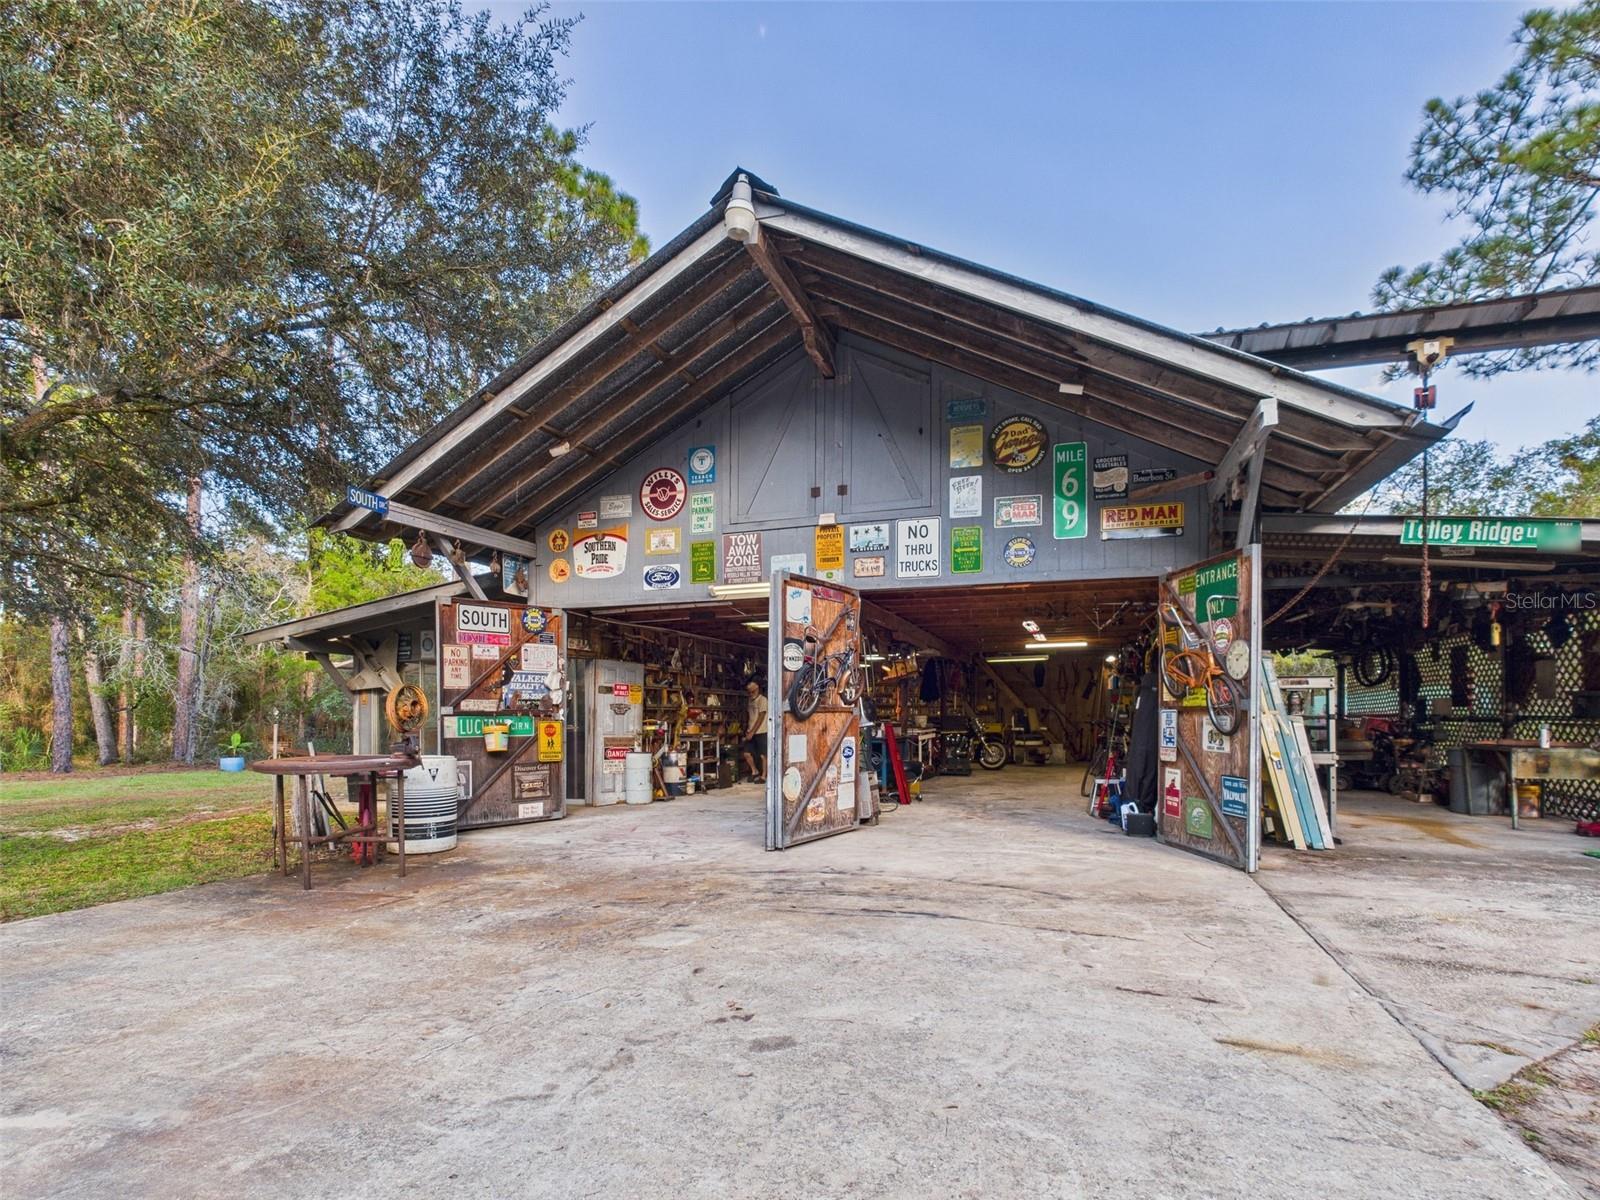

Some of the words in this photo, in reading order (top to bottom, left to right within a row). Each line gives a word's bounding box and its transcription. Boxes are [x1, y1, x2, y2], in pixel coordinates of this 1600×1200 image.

[1056, 449, 1084, 463] MILE
[645, 471, 681, 487] WILLYS
[1062, 467, 1079, 497] 6
[1133, 471, 1163, 481] Bourbon
[350, 488, 378, 510] SOUTH
[693, 496, 712, 505] PERMIT
[692, 506, 714, 515] PARKING
[1062, 500, 1080, 530] 9
[1105, 508, 1138, 523] RED
[1141, 505, 1178, 520] MAN
[908, 525, 929, 539] NO
[1468, 520, 1523, 544] Ridge
[729, 534, 757, 546] TOW
[1008, 537, 1032, 547] SUPER
[584, 541, 616, 553] SOUTHERN
[728, 544, 759, 556] AWAY
[905, 544, 932, 555] THRU
[591, 553, 608, 565] PRIDE
[726, 555, 760, 567] ZONE
[899, 560, 938, 572] TRUCKS
[651, 571, 673, 581] Ford
[1196, 563, 1237, 588] ENTRANCE
[461, 609, 507, 628] SOUTH
[450, 648, 461, 657] NO
[444, 658, 468, 666] PARKING
[537, 763, 549, 771] Gold
